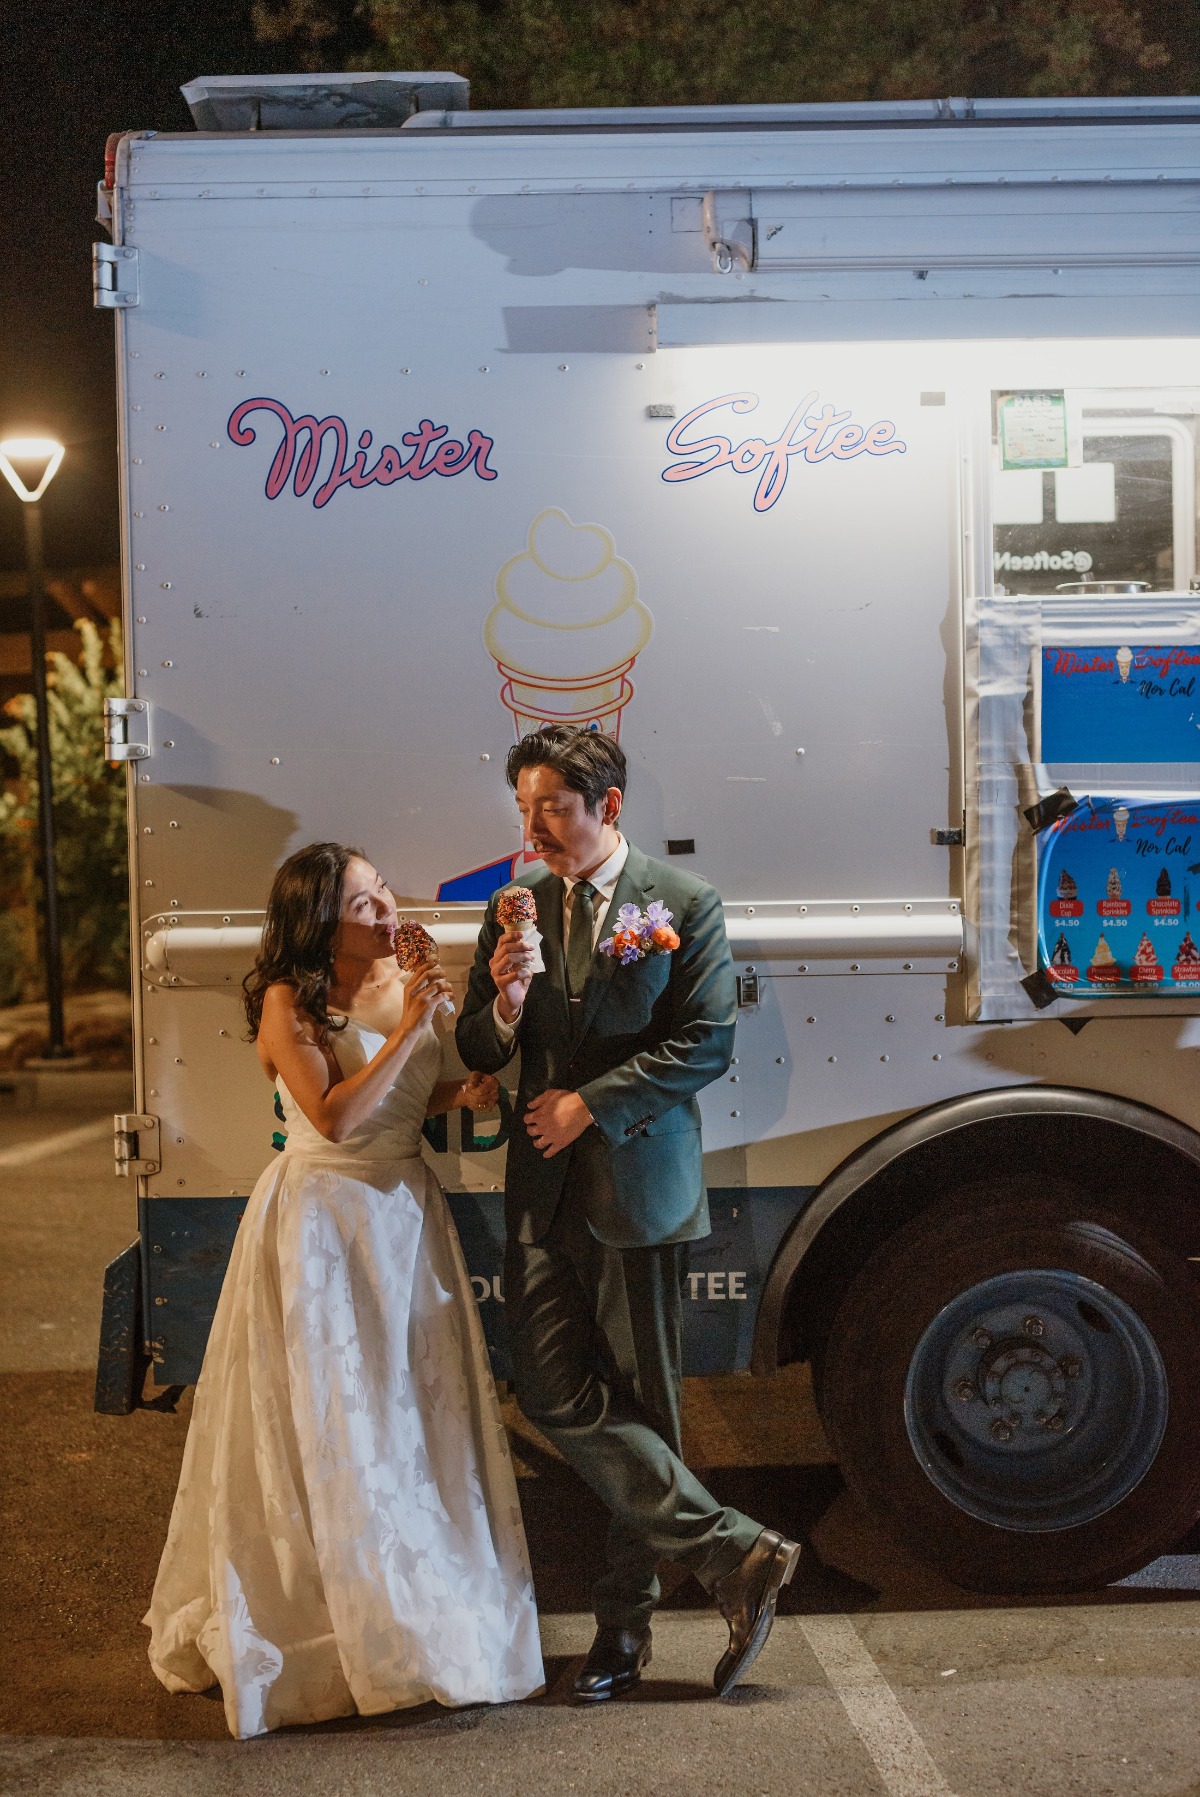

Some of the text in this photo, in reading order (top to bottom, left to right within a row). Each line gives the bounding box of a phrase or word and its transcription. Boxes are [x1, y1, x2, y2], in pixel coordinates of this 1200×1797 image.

[227, 391, 907, 512] Mister Softee
[1045, 645, 1200, 678] Mister Softee
[1139, 676, 1196, 699] Nor Cal
[1129, 805, 1199, 836] Softee
[1135, 836, 1192, 857] Nor Cal
[1059, 901, 1074, 909] Dixie
[1060, 910, 1072, 918] Cup
[1151, 908, 1178, 916] Sprinkles
[1054, 919, 1080, 927] $4.50
[1102, 919, 1128, 927] $4.50
[1153, 918, 1179, 926] $4.50
[1138, 967, 1157, 975] Cherry
